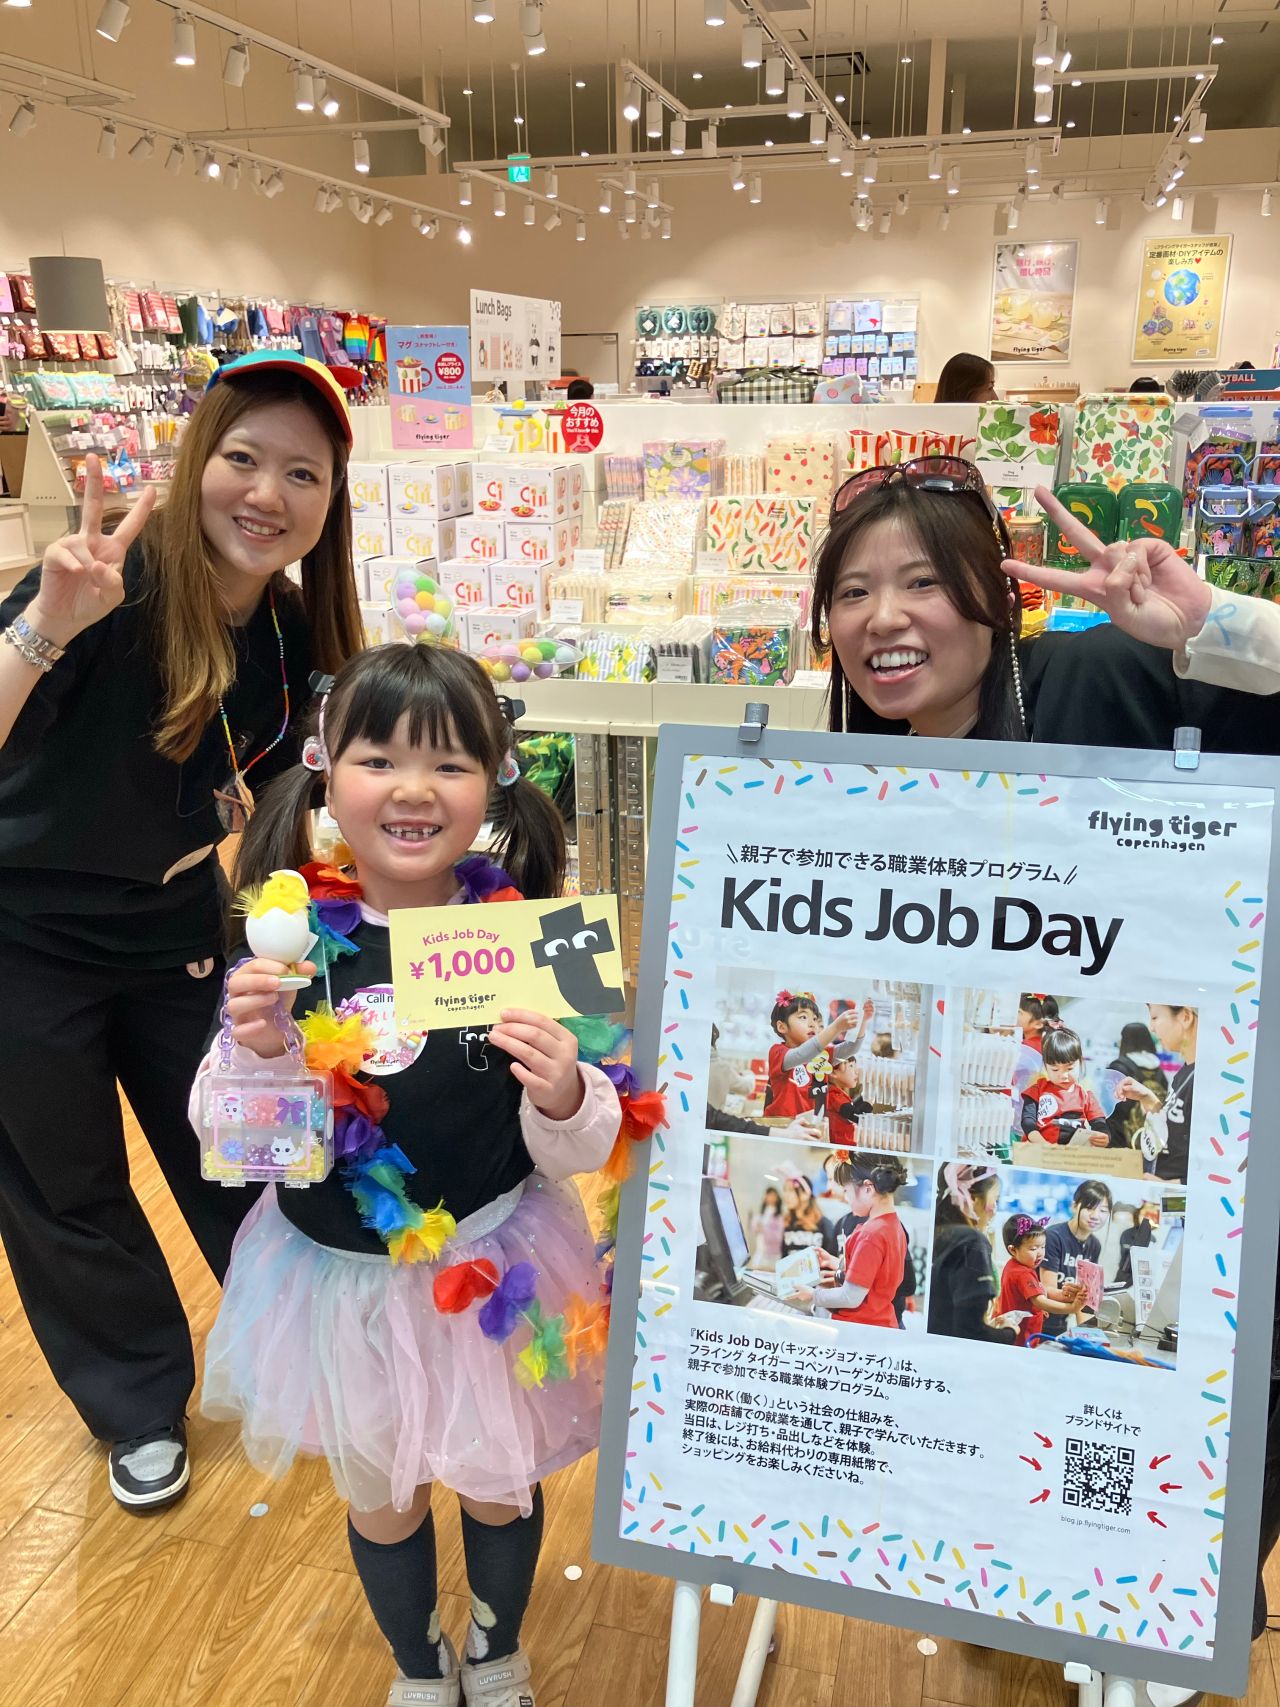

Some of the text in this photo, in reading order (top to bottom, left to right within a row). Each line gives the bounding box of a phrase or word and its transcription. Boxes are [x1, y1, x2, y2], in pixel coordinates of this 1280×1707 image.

[475, 297, 512, 321] Lunch Bags
[438, 367, 461, 375] ¥800
[570, 406, 595, 417] 今月の
[565, 417, 600, 428] おすすめ
[1088, 810, 1238, 840] flying tiger
[1116, 837, 1206, 853] copenhagen
[720, 876, 1124, 976] Kids Job Day
[422, 928, 501, 947] Kids Job Day
[366, 994, 394, 1004] Call m
[434, 992, 497, 1007] flying tiger
[447, 1003, 485, 1012] copenhagen
[727, 1333, 750, 1348] Job
[689, 1343, 952, 1394] フライング タイガー コペンハーゲンがお届けする、
[687, 1357, 891, 1401] 親子で参加できる職業体験プログラム。
[1083, 1403, 1123, 1420] 詳しくは
[1065, 1414, 1142, 1437] ブランドサイトで
[681, 1442, 865, 1485] ショッピングをお楽しみくださいね。
[1060, 1514, 1132, 1535] blog.jp.flyingtiger.com
[479, 1671, 513, 1686] LUVRUSH
[403, 1691, 437, 1702] LUVRUSH
